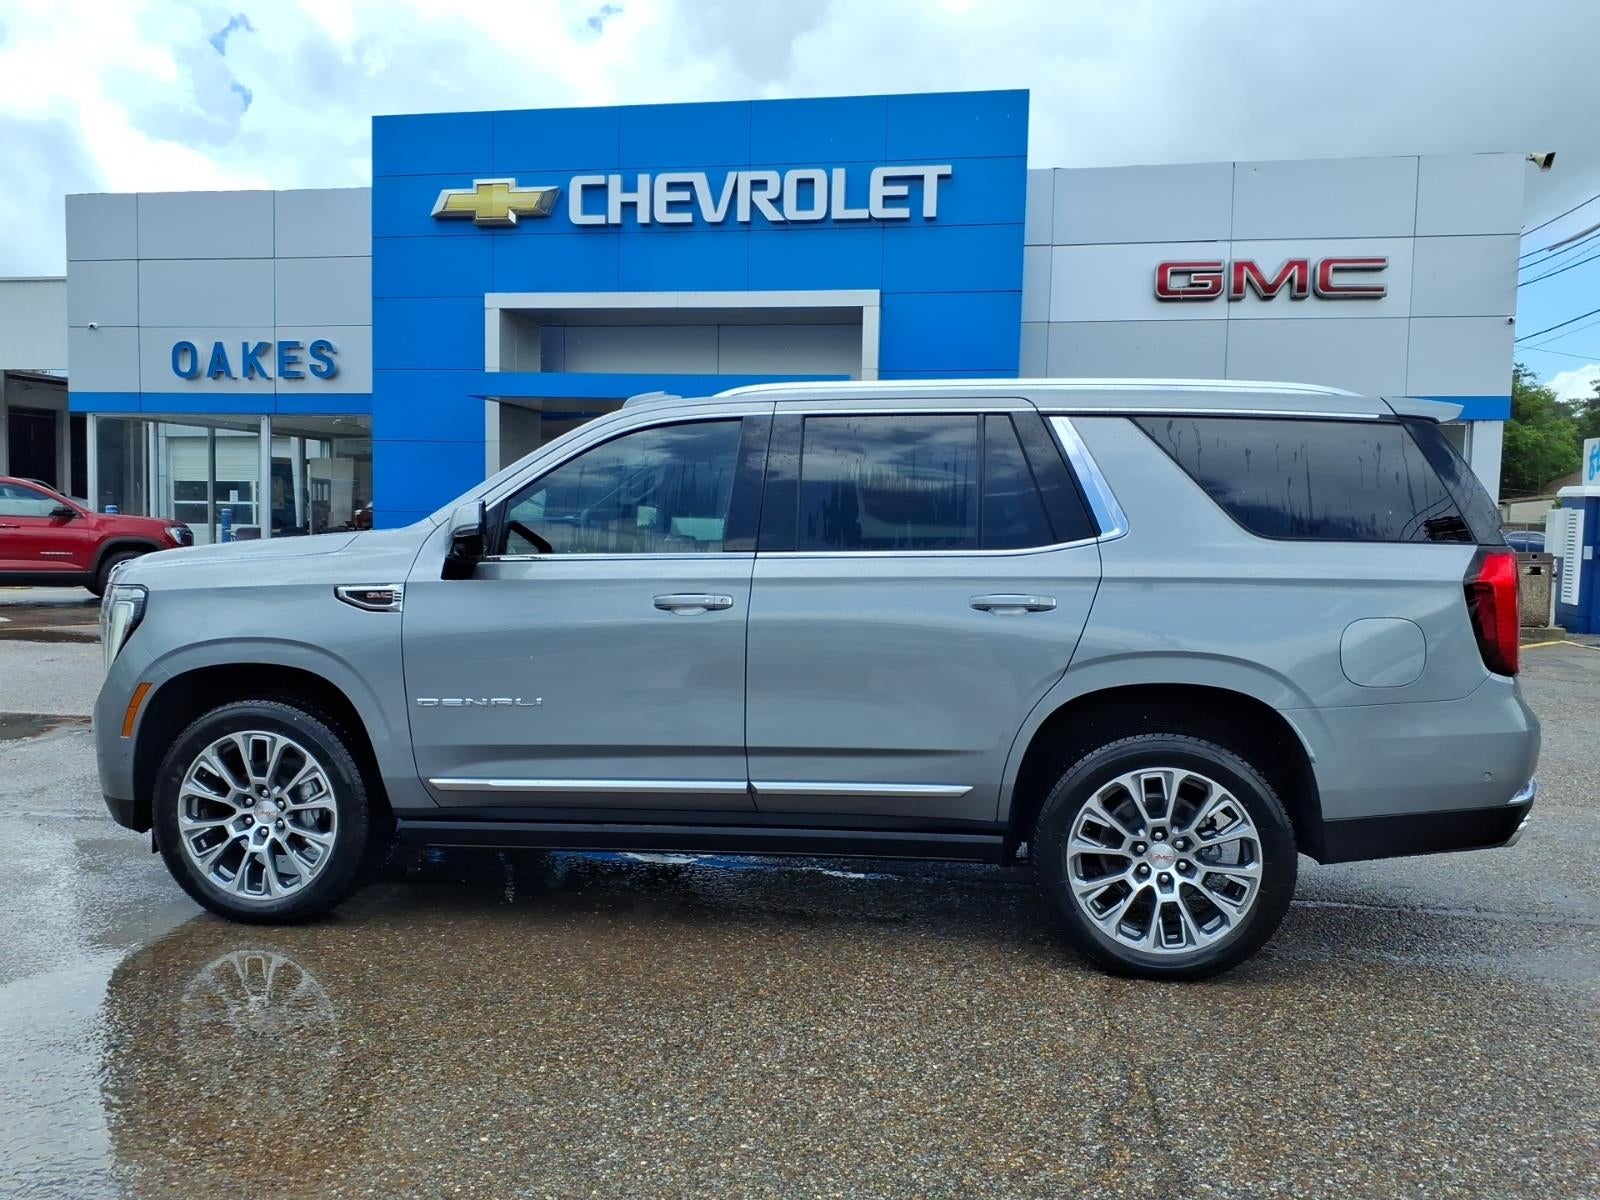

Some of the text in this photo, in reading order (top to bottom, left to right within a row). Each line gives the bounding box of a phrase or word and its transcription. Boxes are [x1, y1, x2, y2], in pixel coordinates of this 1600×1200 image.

[568, 164, 952, 225] CHEVROLET
[1155, 257, 1389, 301] GMC
[171, 339, 338, 380] OAKES
[366, 591, 393, 599] GMC
[416, 697, 543, 707] DENALI
